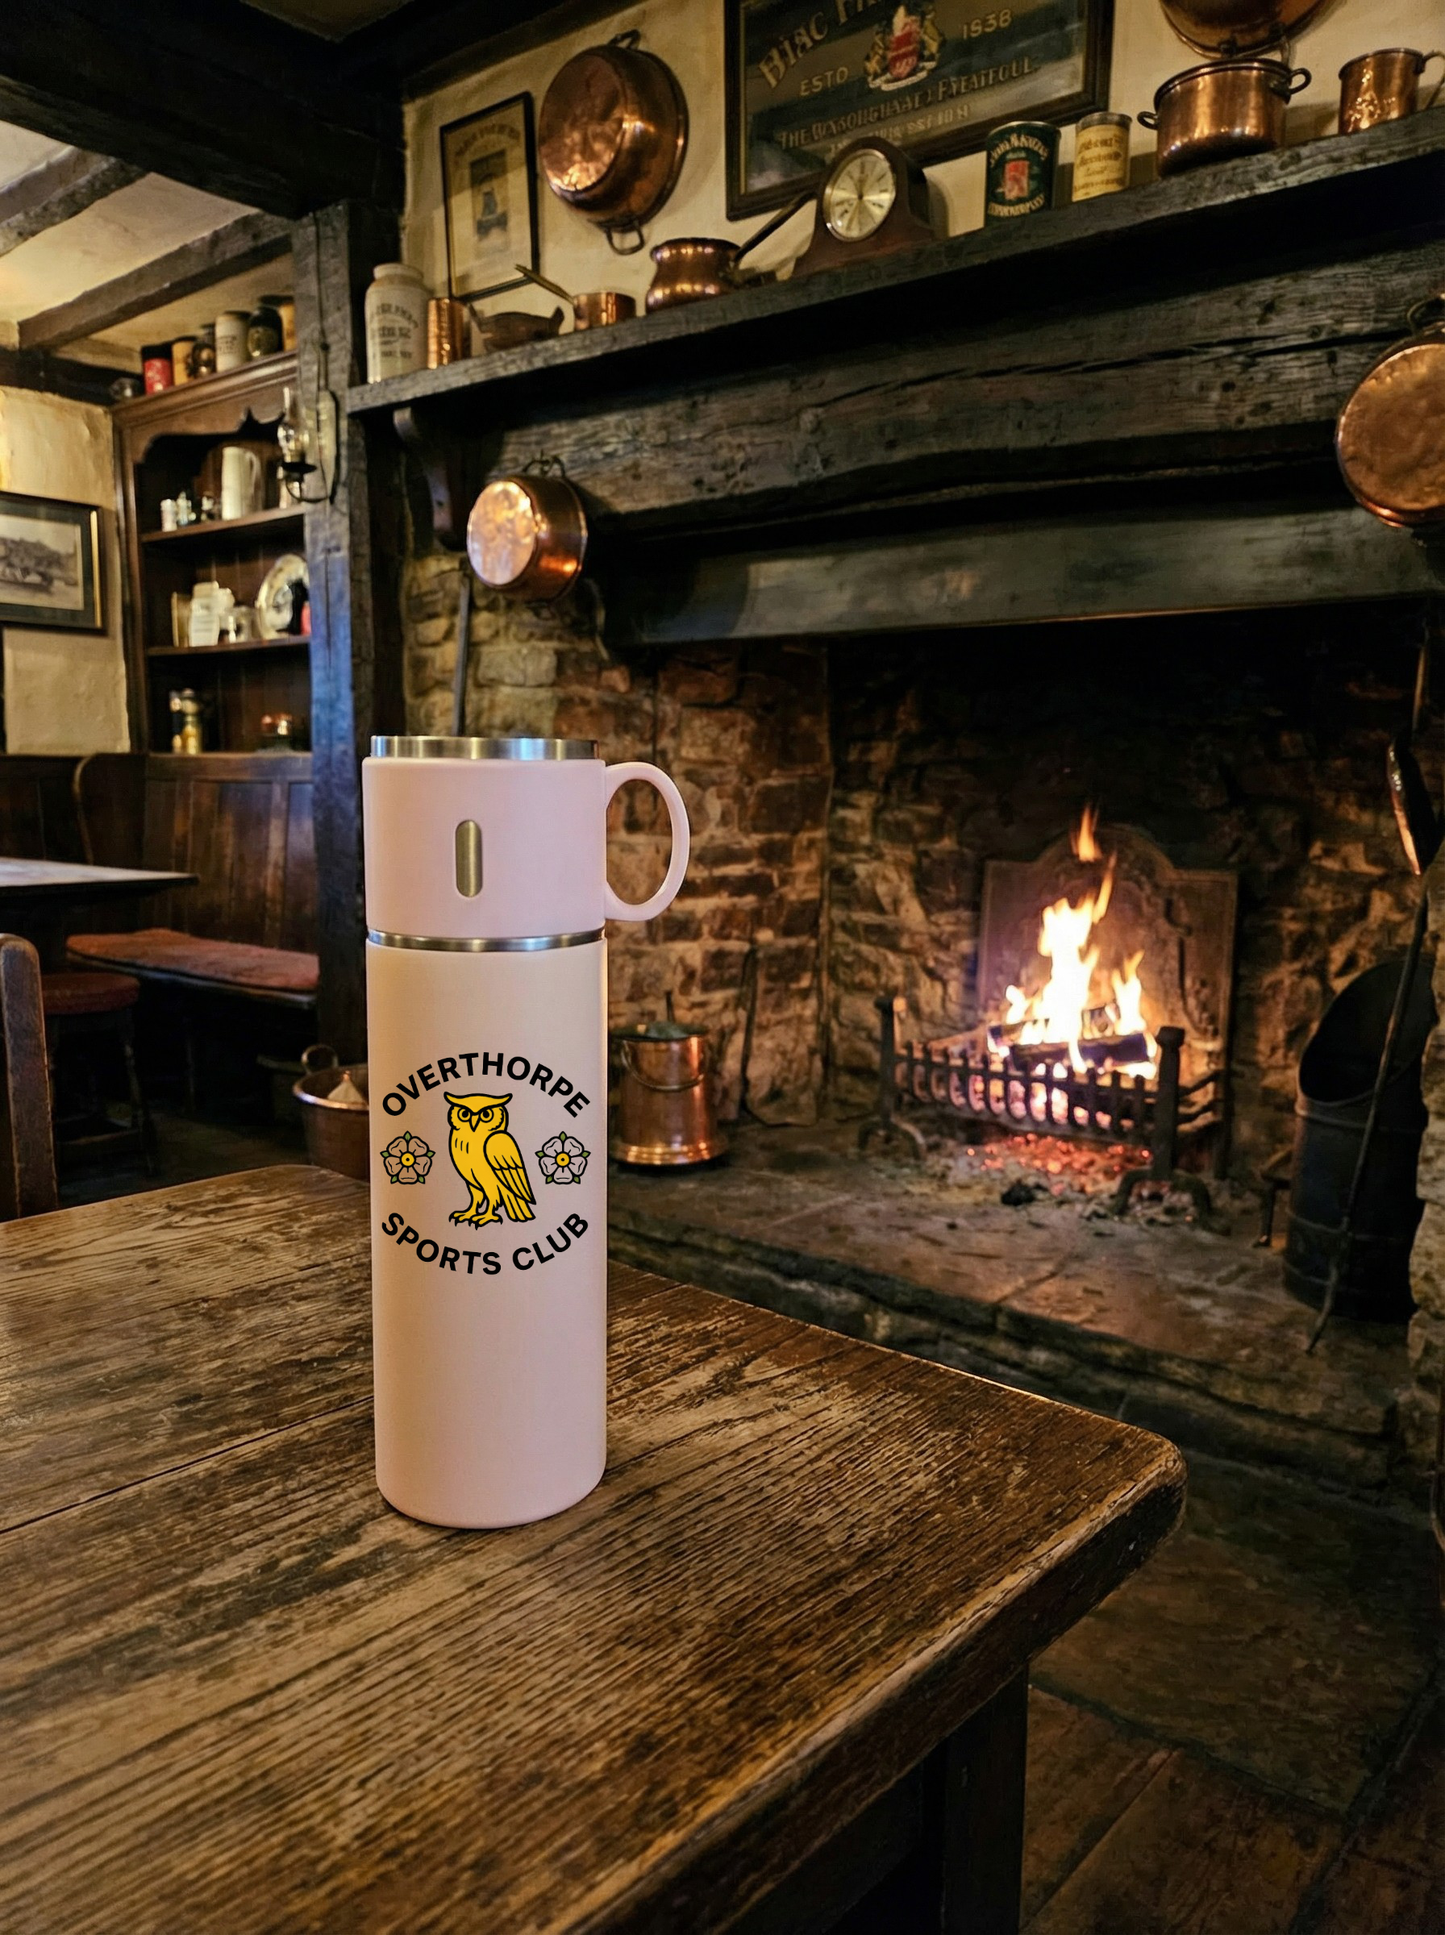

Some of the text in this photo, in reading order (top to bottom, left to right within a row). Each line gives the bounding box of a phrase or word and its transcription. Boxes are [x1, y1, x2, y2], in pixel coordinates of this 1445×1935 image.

[382, 1052, 591, 1118] OVERTHORPE
[382, 1212, 589, 1275] SPORTS CLUB
